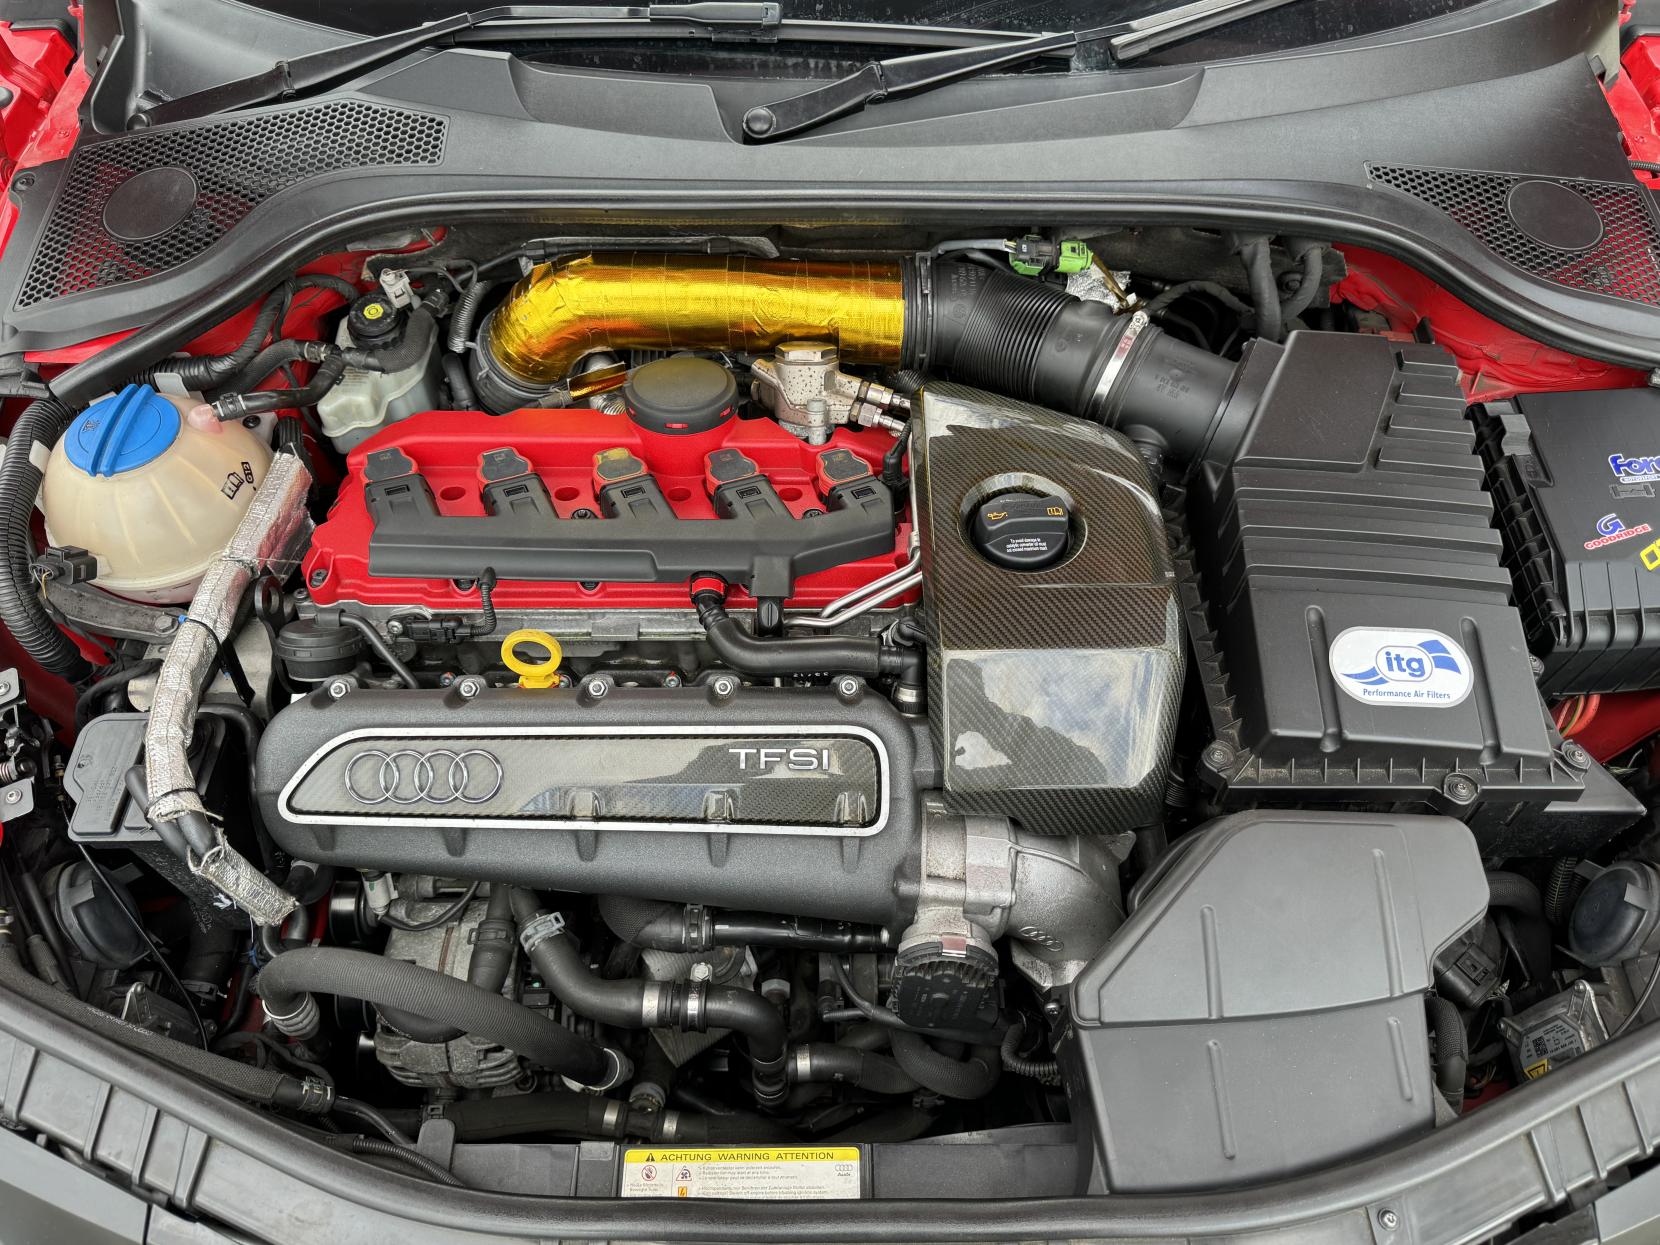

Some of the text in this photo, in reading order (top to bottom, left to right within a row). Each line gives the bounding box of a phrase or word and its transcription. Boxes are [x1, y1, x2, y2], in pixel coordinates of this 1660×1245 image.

[1584, 524, 1651, 549] GOODRIDGE
[1385, 651, 1426, 678] itg
[1363, 688, 1451, 699] Performance Air Filters
[728, 748, 829, 770] TFSI
[660, 1152, 834, 1161] ACHTUNG WARNING ATTENTION
